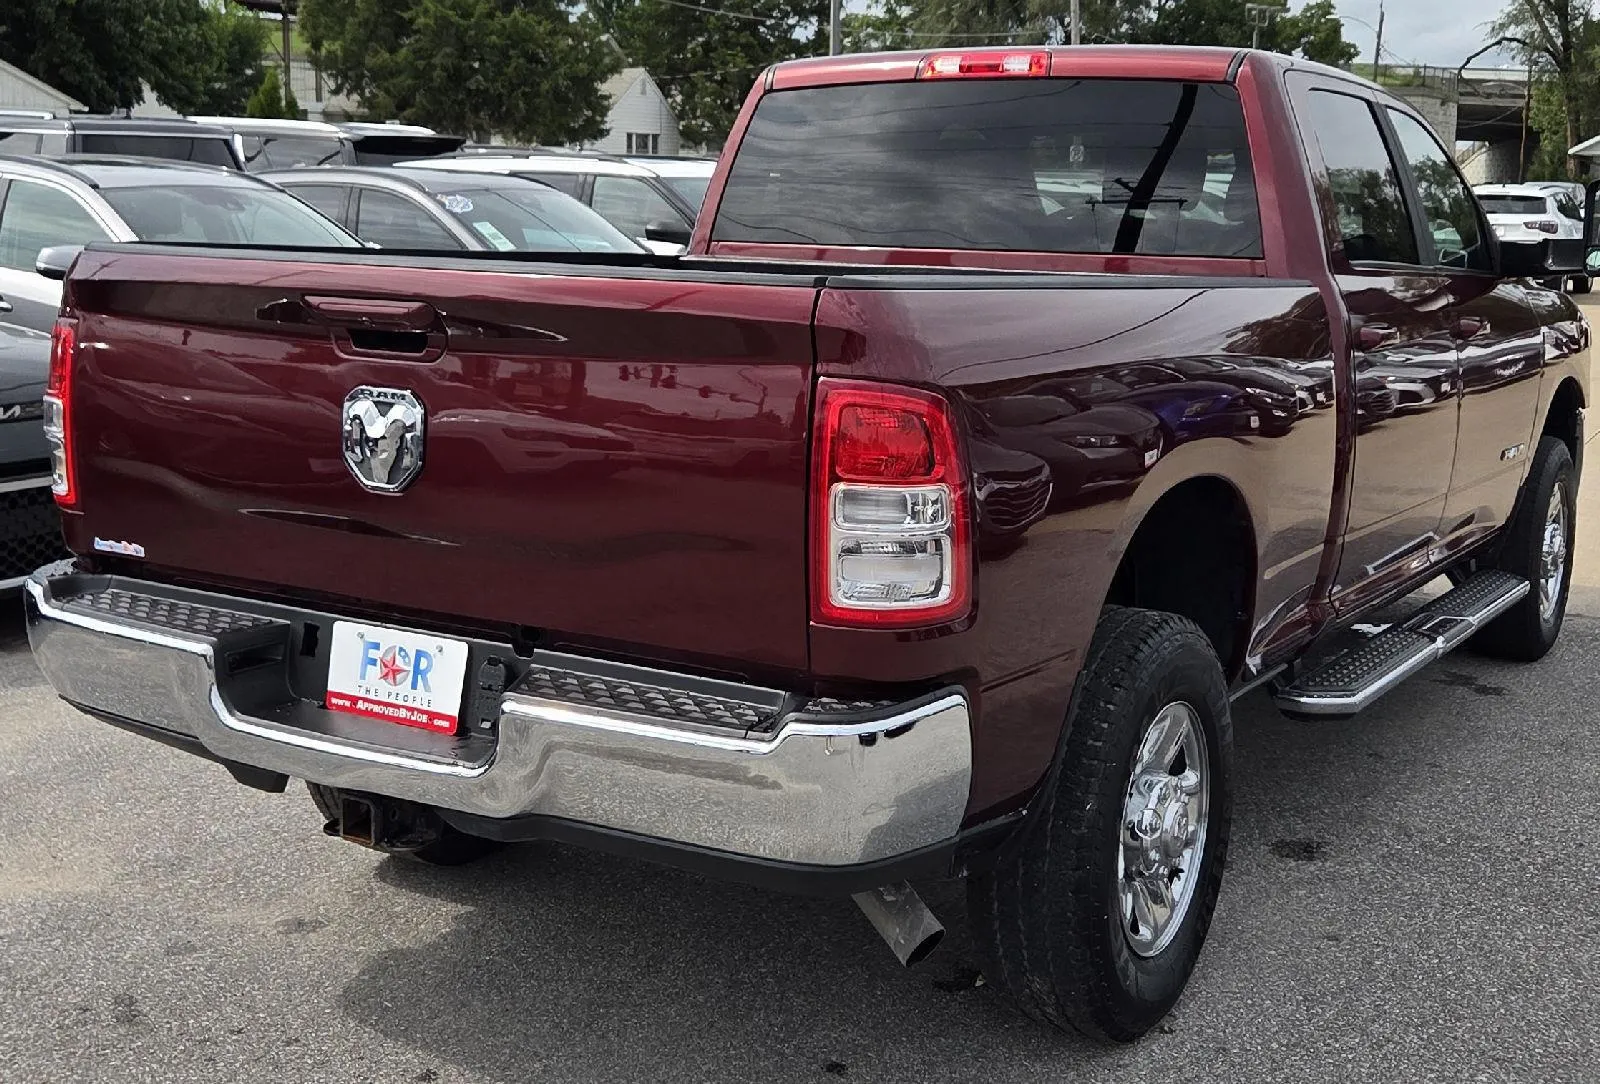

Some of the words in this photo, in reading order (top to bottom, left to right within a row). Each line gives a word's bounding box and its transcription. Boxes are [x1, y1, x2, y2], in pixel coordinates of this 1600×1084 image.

[359, 388, 406, 401] RAM
[359, 639, 434, 693] FOR
[357, 684, 379, 697] THE
[387, 691, 432, 708] PEOPLE
